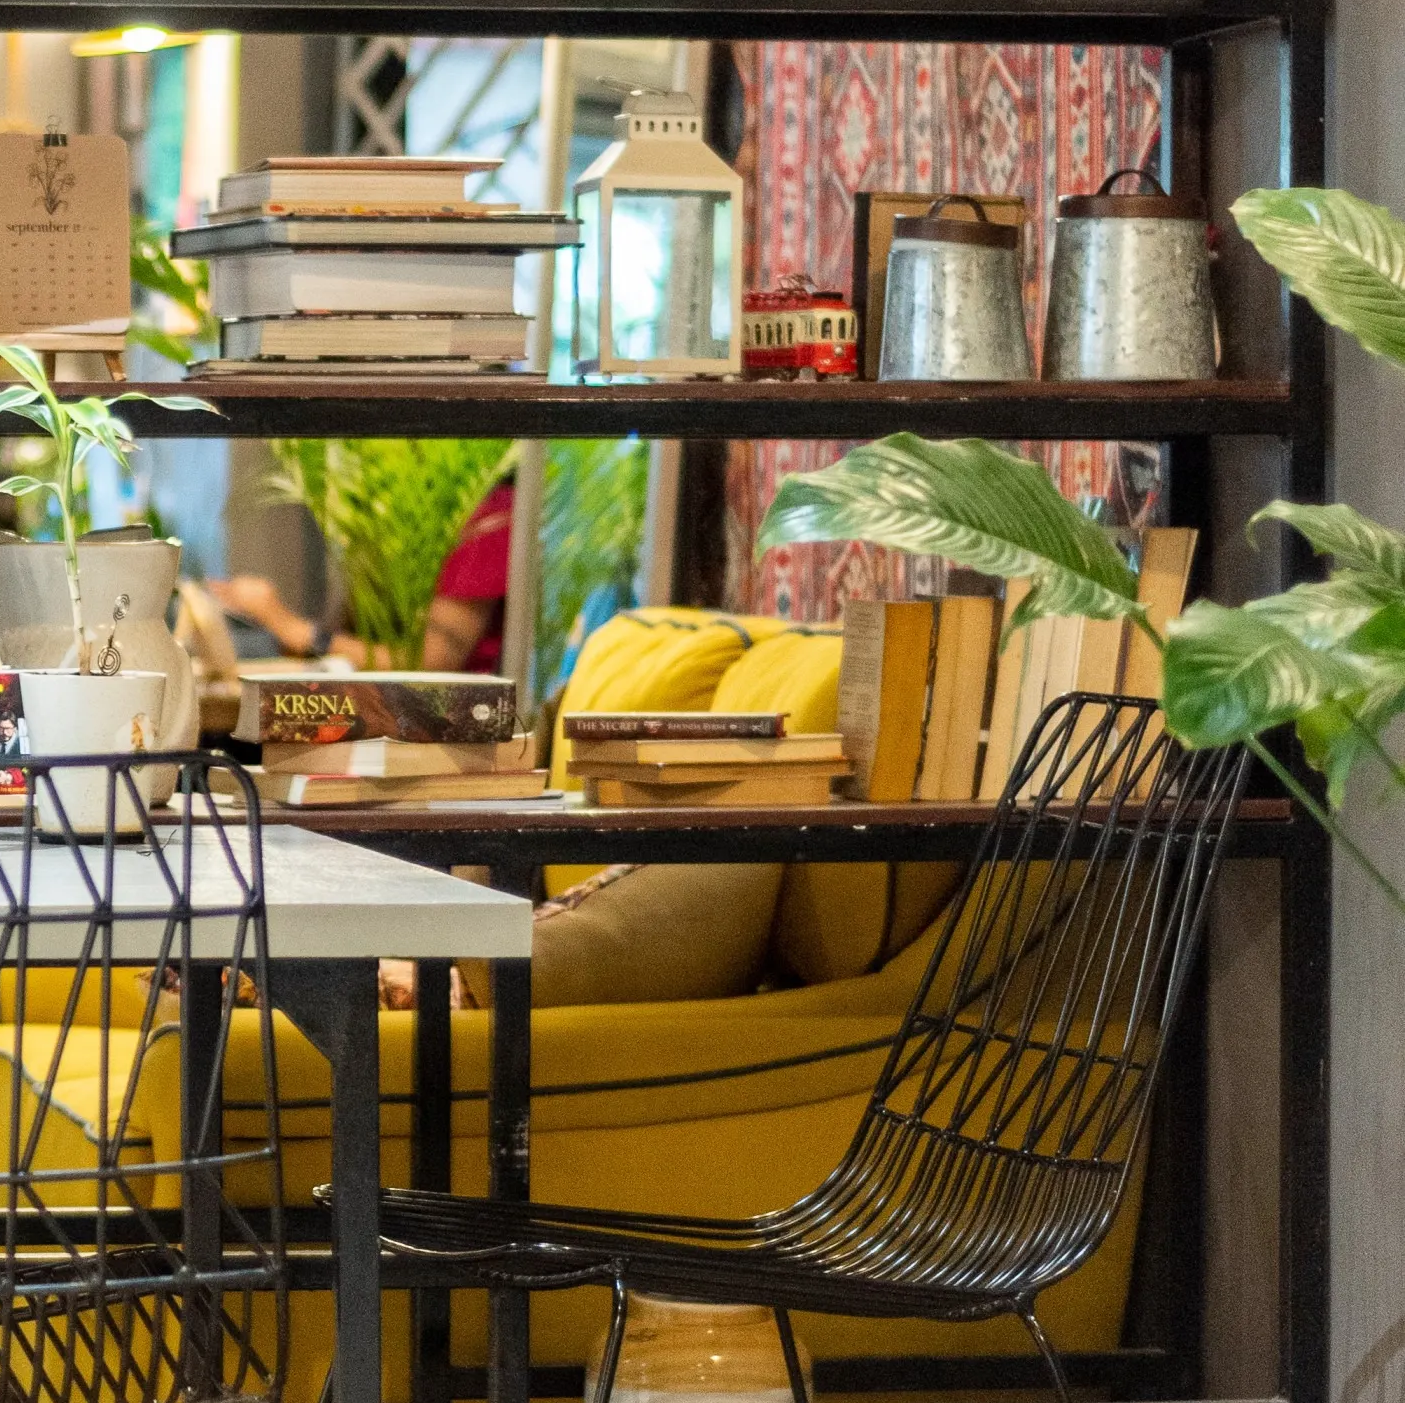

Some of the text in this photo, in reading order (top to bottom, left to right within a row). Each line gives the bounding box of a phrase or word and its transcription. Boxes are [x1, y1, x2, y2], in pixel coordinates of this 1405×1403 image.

[5, 221, 69, 236] september
[274, 694, 356, 715] KRSNA
[576, 720, 596, 731] THE
[599, 721, 638, 731] SECRET
